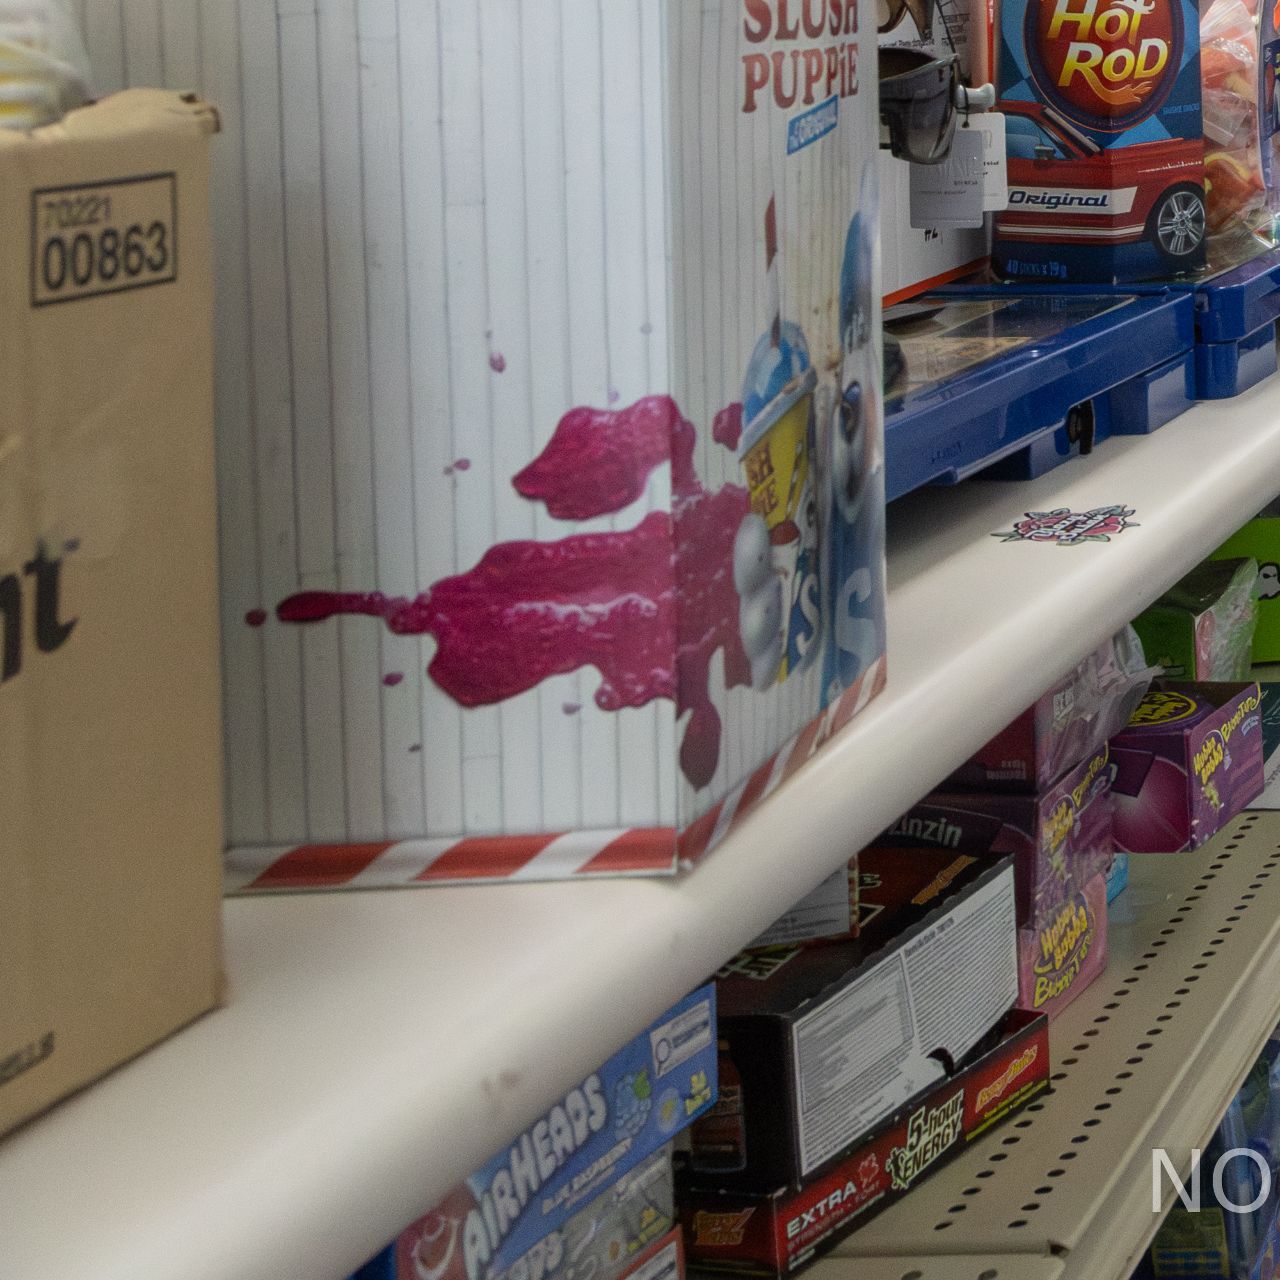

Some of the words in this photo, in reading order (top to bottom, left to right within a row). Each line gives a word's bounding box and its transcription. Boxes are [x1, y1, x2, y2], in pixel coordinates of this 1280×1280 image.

[1008, 189, 1108, 209] Original
[43, 221, 168, 290] 00863
[903, 1113, 963, 1180] ENERGY
[908, 1089, 964, 1152] 5-hour
[463, 1072, 609, 1280] AIRHEADS
[786, 1181, 857, 1239] EXTRA
